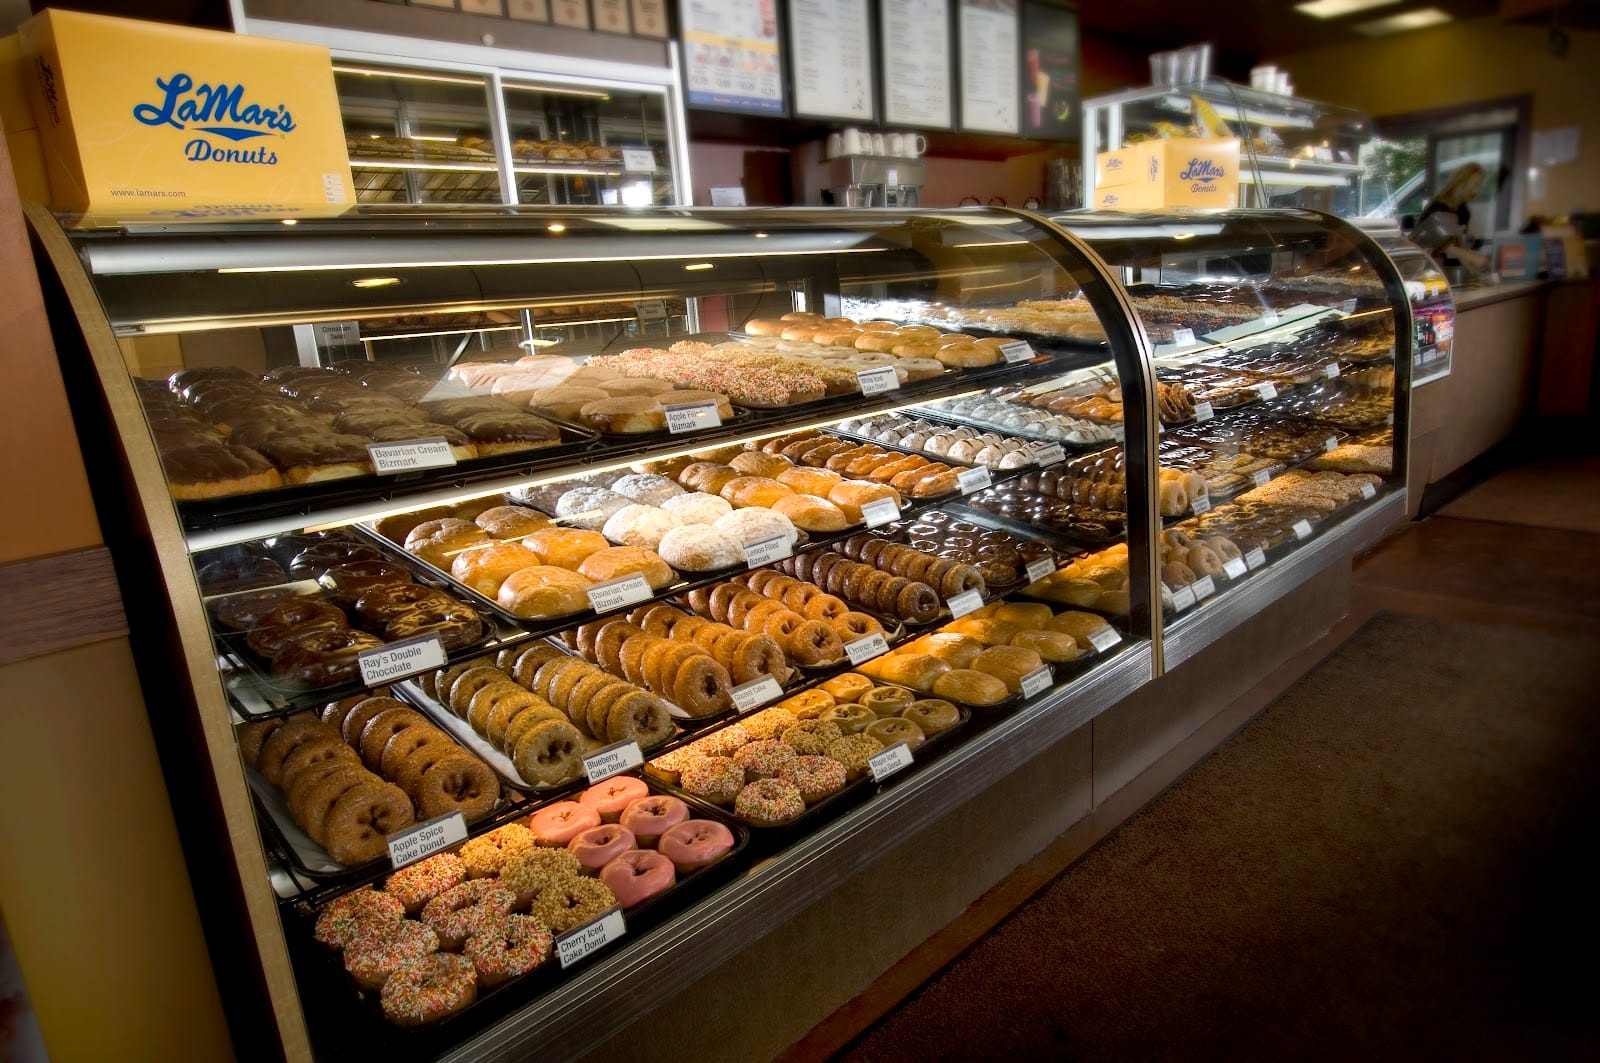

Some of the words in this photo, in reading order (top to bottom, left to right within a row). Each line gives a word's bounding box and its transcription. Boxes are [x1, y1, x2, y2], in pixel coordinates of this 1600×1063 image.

[133, 73, 297, 132] LaMar's
[184, 139, 278, 165] Donuts
[1179, 157, 1224, 181] LaMar's
[111, 188, 186, 198] www.lamars.com
[668, 411, 687, 422] Apple
[670, 420, 697, 431] Bizmark
[374, 447, 417, 459] Bavarian
[417, 444, 448, 455] Cream
[379, 457, 418, 469] Bizmark
[590, 587, 622, 600] Bavarian
[621, 579, 644, 592] Cream
[595, 595, 625, 609] Bizmark
[362, 656, 389, 670] Ray's
[390, 647, 422, 662] Double
[366, 661, 412, 680] Chocolate
[586, 752, 619, 770] Blueberry
[590, 767, 608, 780] Cake
[607, 759, 628, 773] Donut
[393, 836, 418, 854] Apple
[419, 825, 444, 842] Spice
[395, 848, 418, 864] Cake
[420, 836, 446, 854] Donut
[560, 933, 587, 953] Cherry
[587, 922, 604, 938] Iced
[563, 948, 584, 964] Cake
[584, 934, 607, 953] Donut
